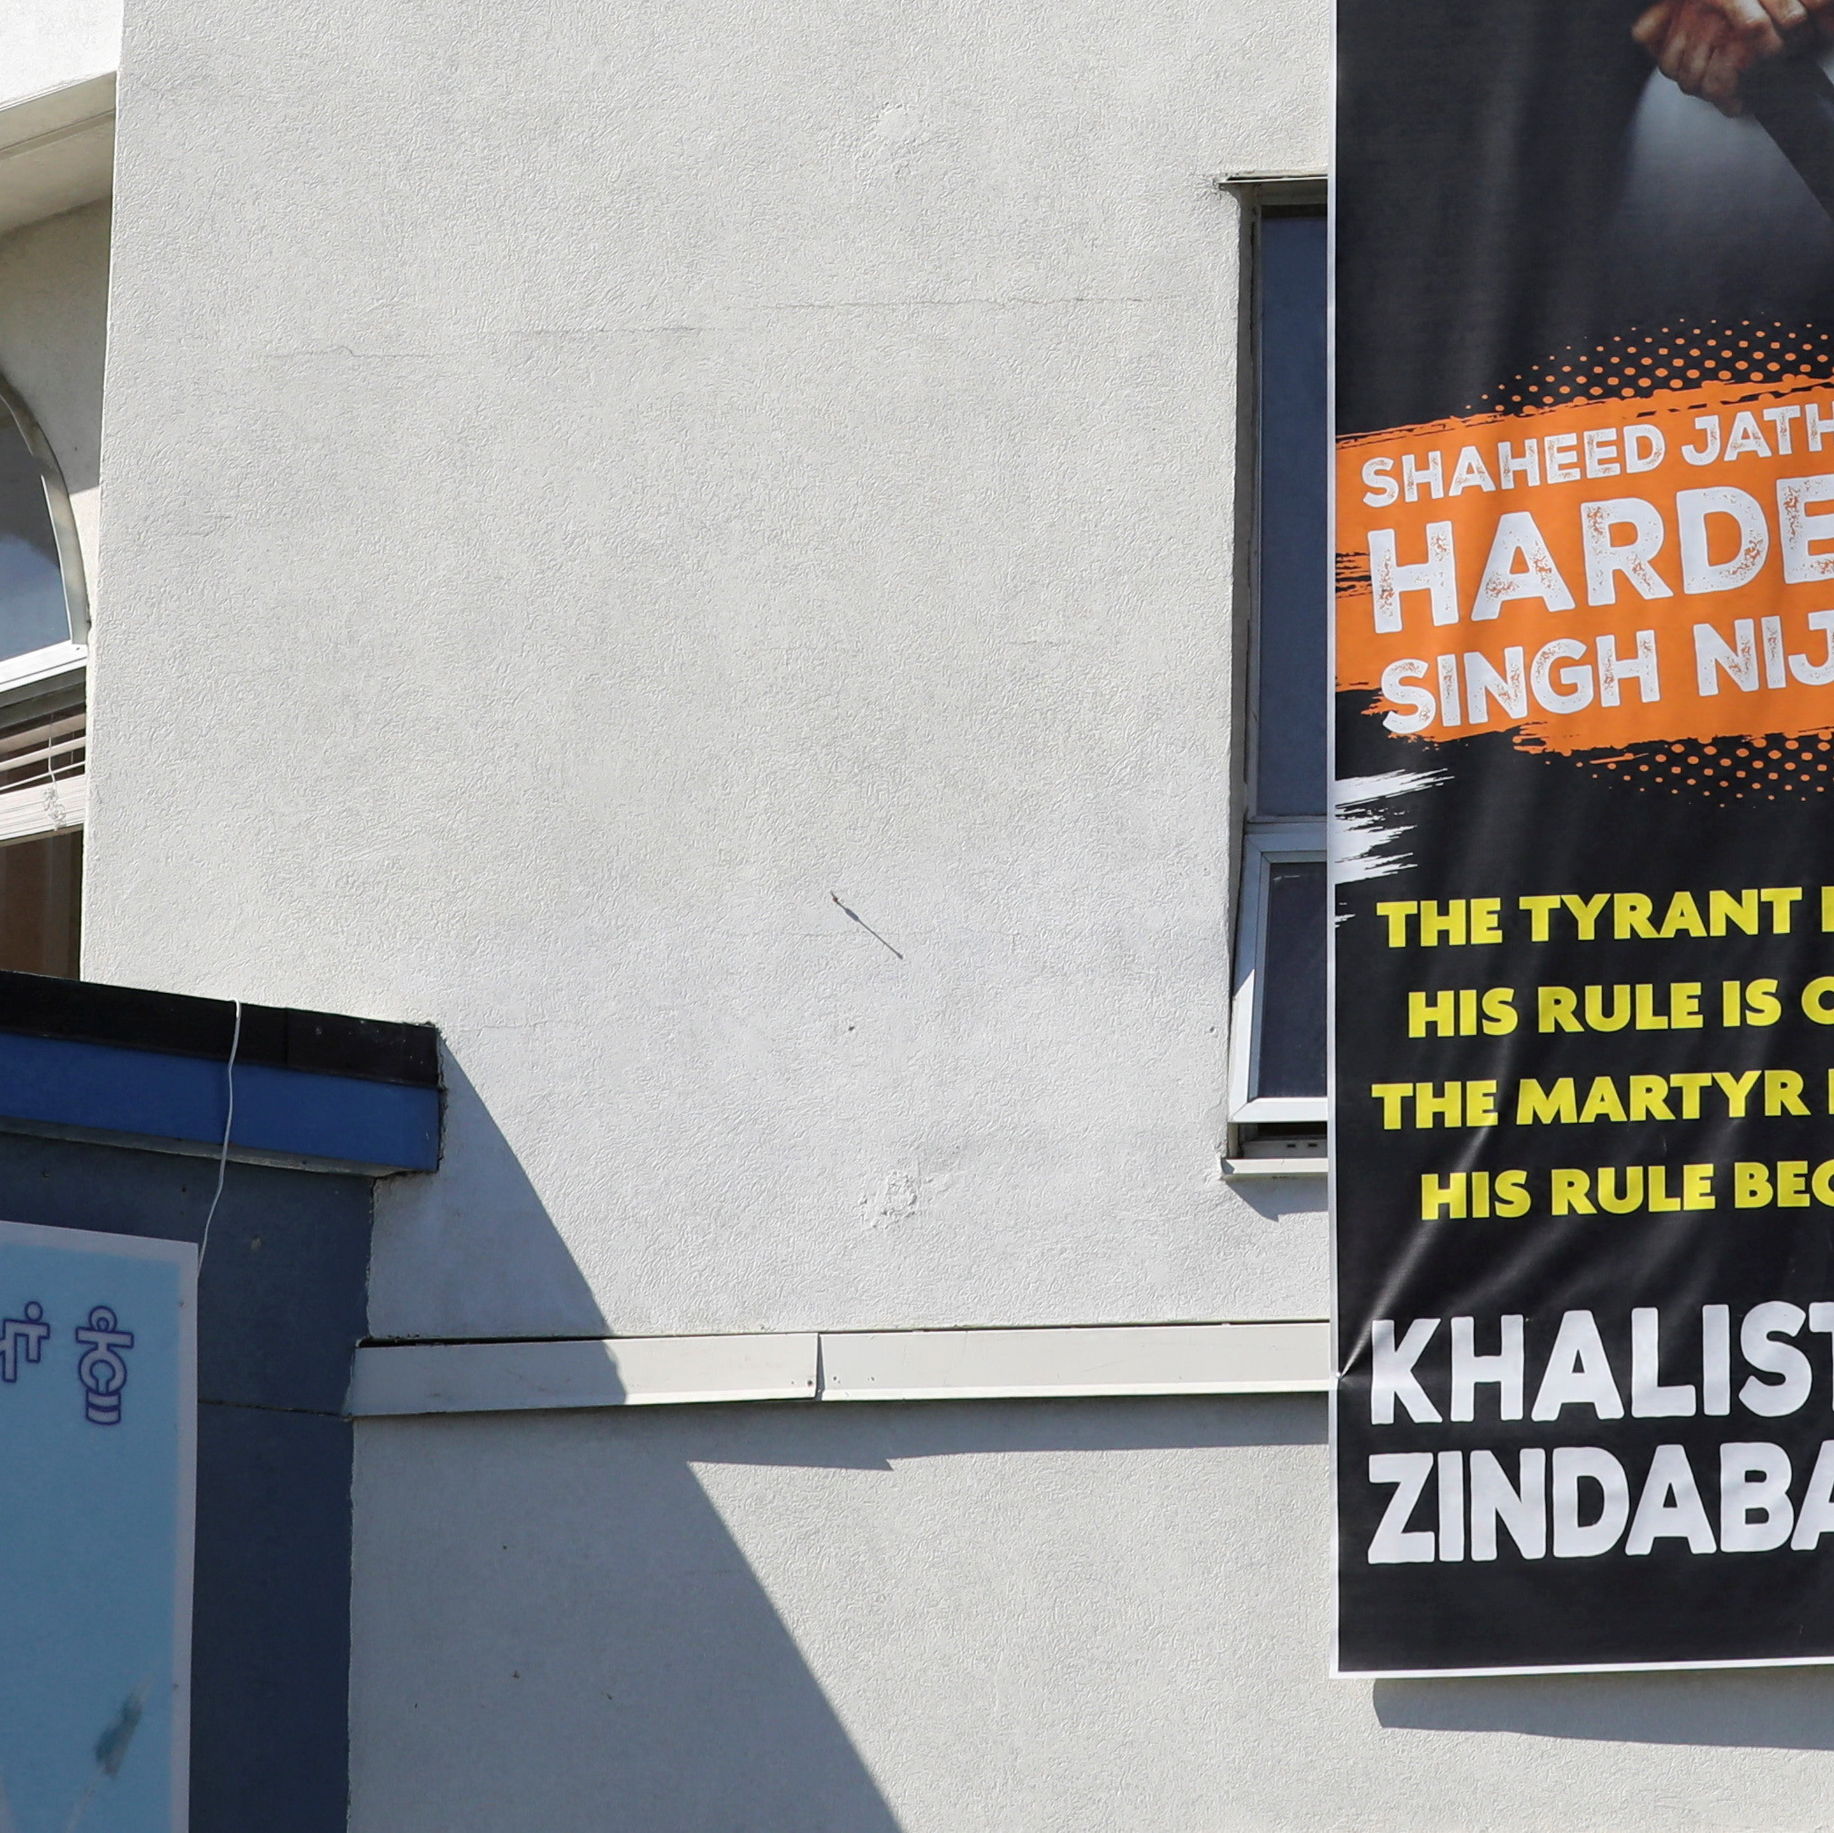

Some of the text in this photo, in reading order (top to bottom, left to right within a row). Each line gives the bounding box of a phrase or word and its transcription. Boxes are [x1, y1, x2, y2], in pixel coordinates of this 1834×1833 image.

[1360, 422, 1667, 510] SHAHEED
[1377, 628, 1662, 737] SINGH
[1375, 897, 1504, 949] THE
[1517, 885, 1804, 943] TYRANT
[1407, 986, 1520, 1039] HIS
[1537, 981, 1704, 1034] RULE
[1721, 977, 1783, 1028] IS
[1370, 1078, 1500, 1131] THE
[1515, 1068, 1812, 1126] MARTYR
[1420, 1168, 1533, 1222] HIS
[1550, 1163, 1717, 1217] RULE
[74, 1304, 134, 1426] ਨੂੰ
